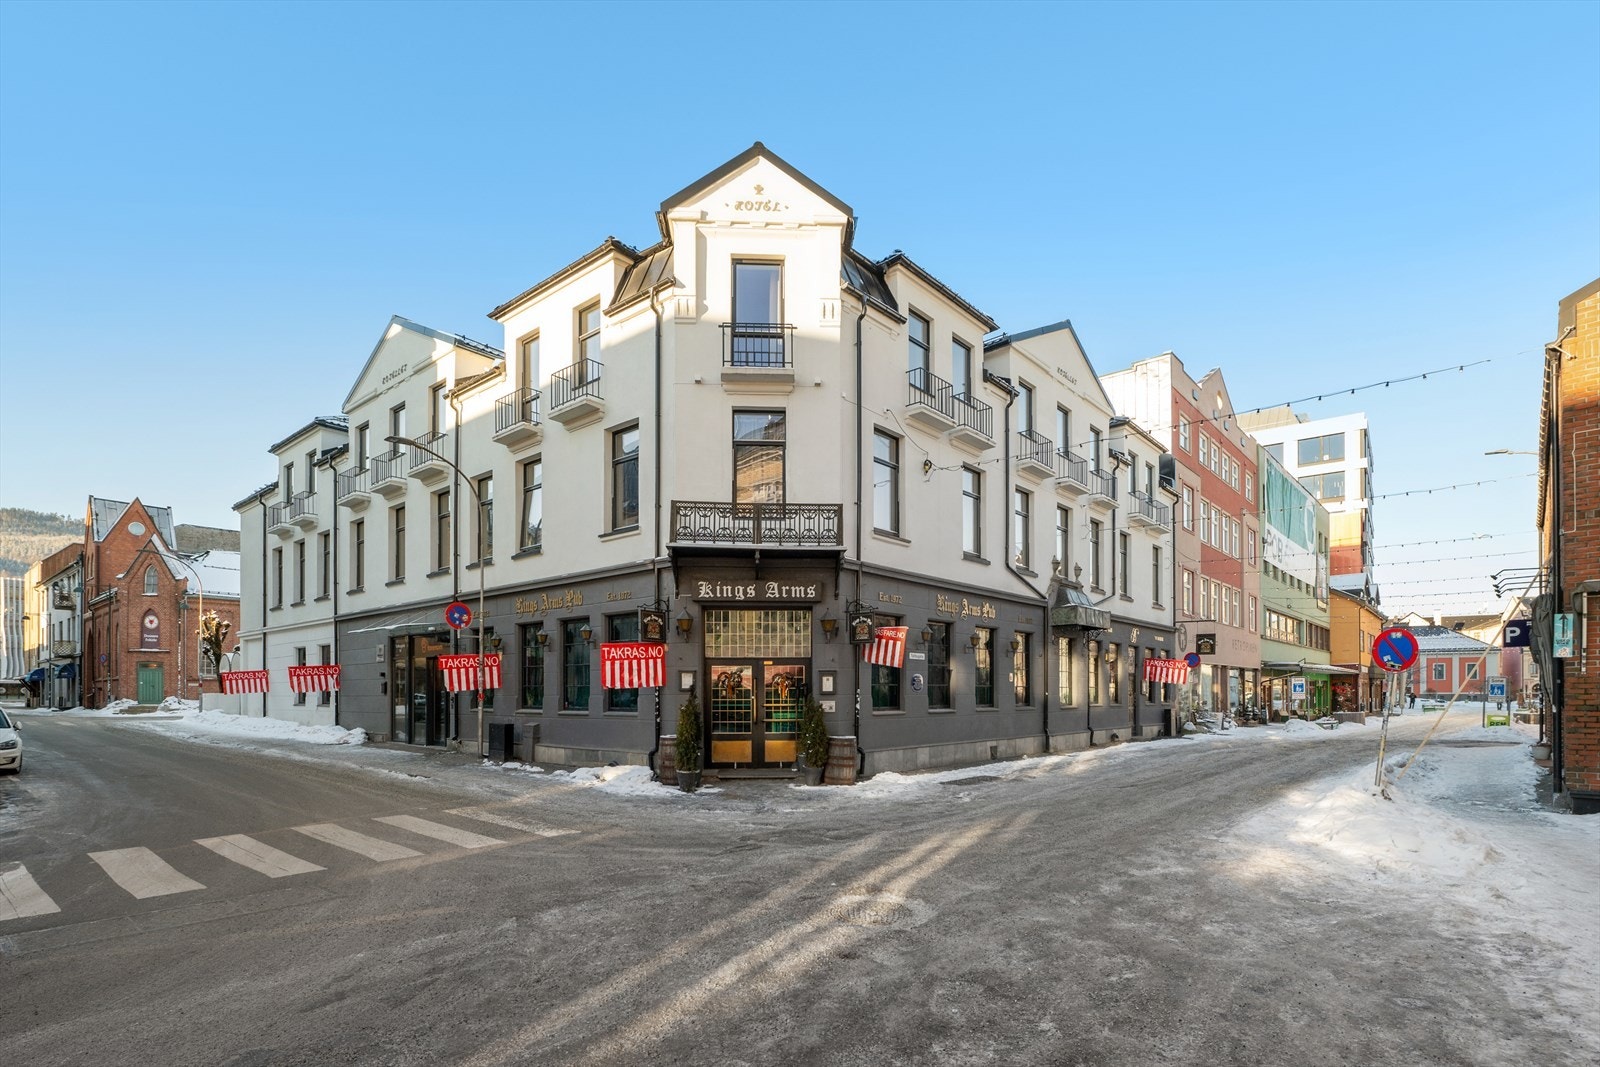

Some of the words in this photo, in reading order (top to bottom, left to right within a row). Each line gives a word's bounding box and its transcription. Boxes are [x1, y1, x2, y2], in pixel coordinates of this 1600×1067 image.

[697, 581, 756, 600] Kings
[765, 581, 816, 598] Arms
[515, 597, 539, 619] Kings
[540, 593, 563, 617] Arms
[564, 589, 584, 613] Pub
[936, 594, 960, 618] Kings
[961, 598, 981, 621] Arms
[981, 601, 996, 623] Pub
[874, 628, 905, 639] RASFARE.NO
[1505, 627, 1521, 643] P
[602, 646, 664, 659] TAKRAS.NO
[440, 656, 499, 668] TAKRASNO
[1146, 660, 1187, 670] TAKRAS.NO
[223, 671, 267, 680] TAKRAS.NO
[290, 667, 339, 676] TAKRAS.NO
